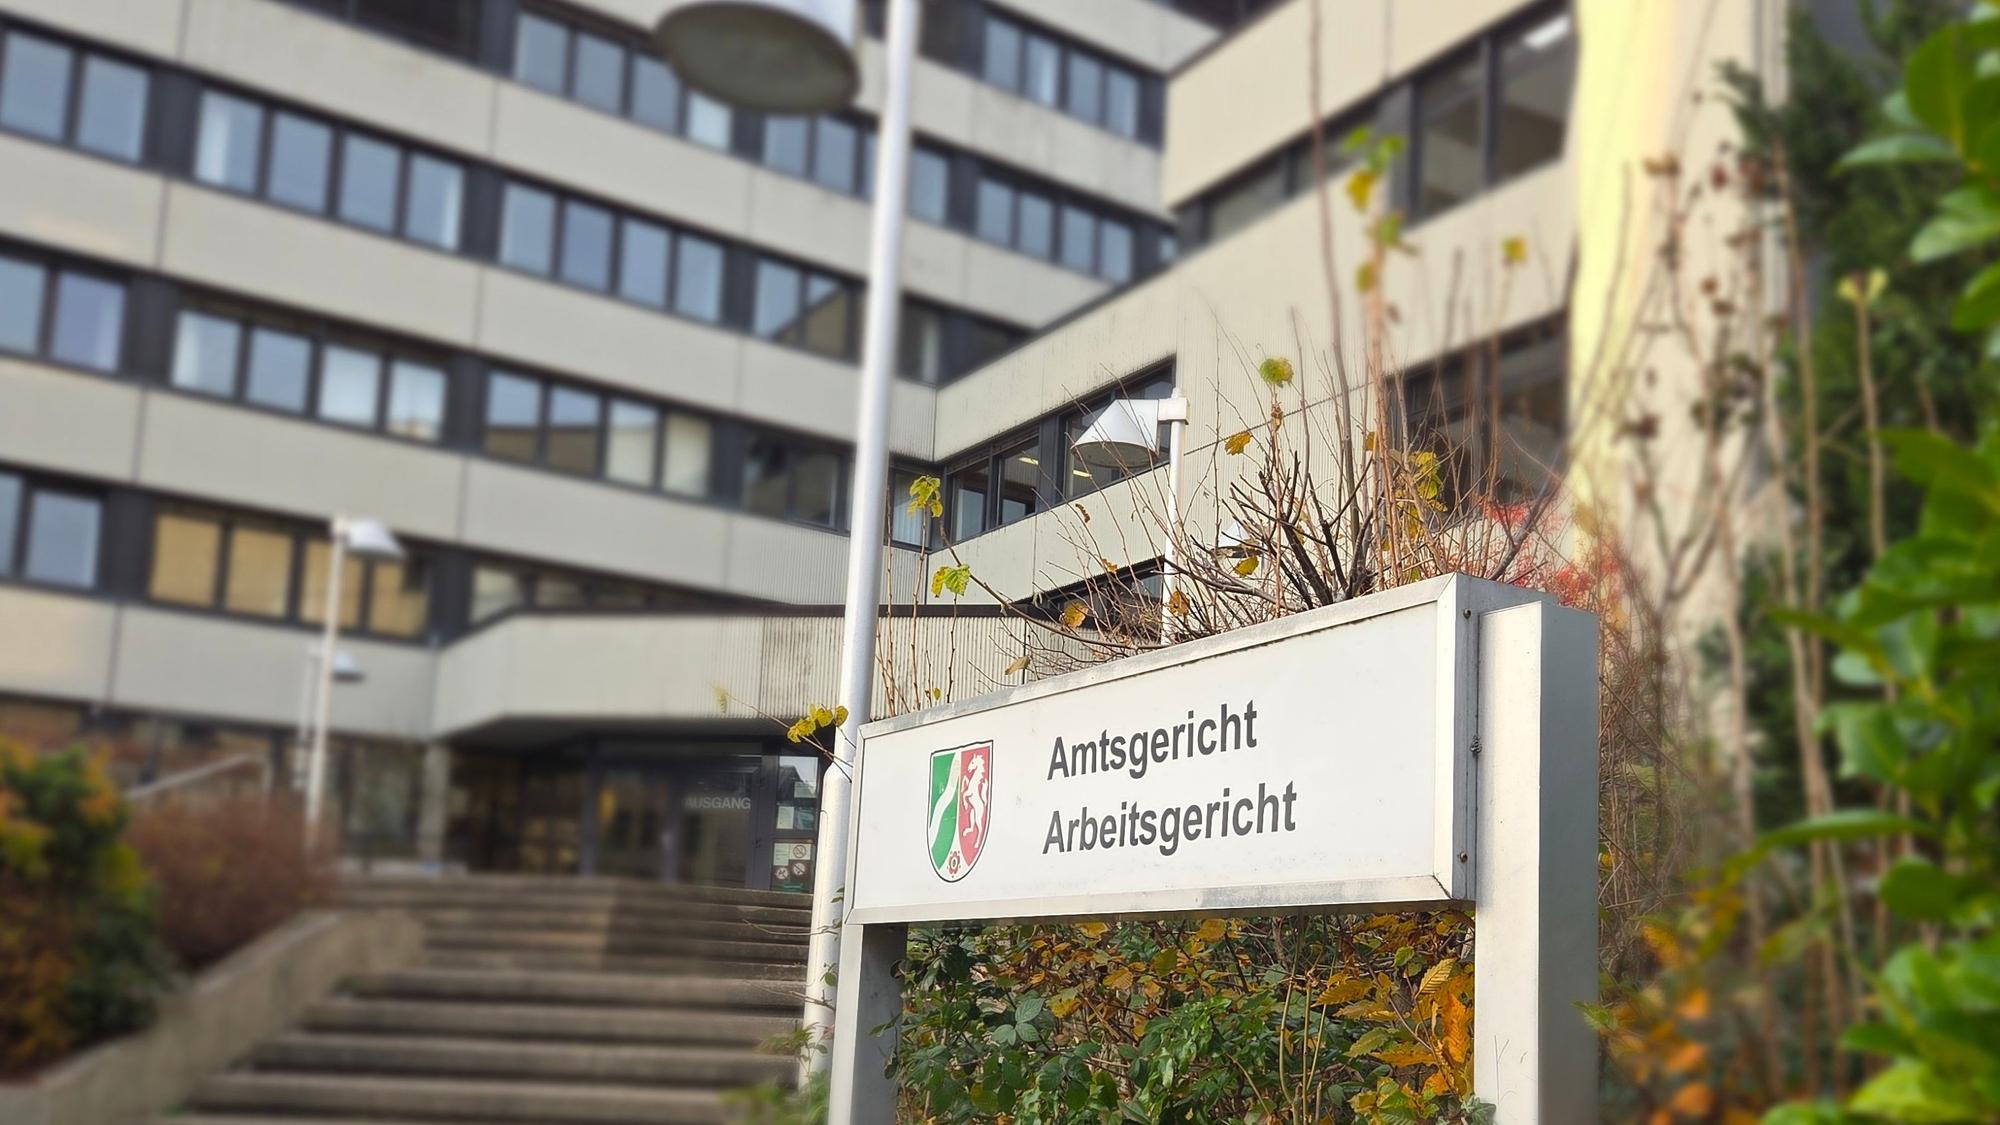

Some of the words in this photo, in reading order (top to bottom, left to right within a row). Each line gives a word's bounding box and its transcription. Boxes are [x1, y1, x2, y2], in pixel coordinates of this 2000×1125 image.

[1047, 700, 1257, 780] Amtsgericht
[685, 796, 752, 810] AUSGANG
[1042, 781, 1297, 857] Arbeitsgericht
